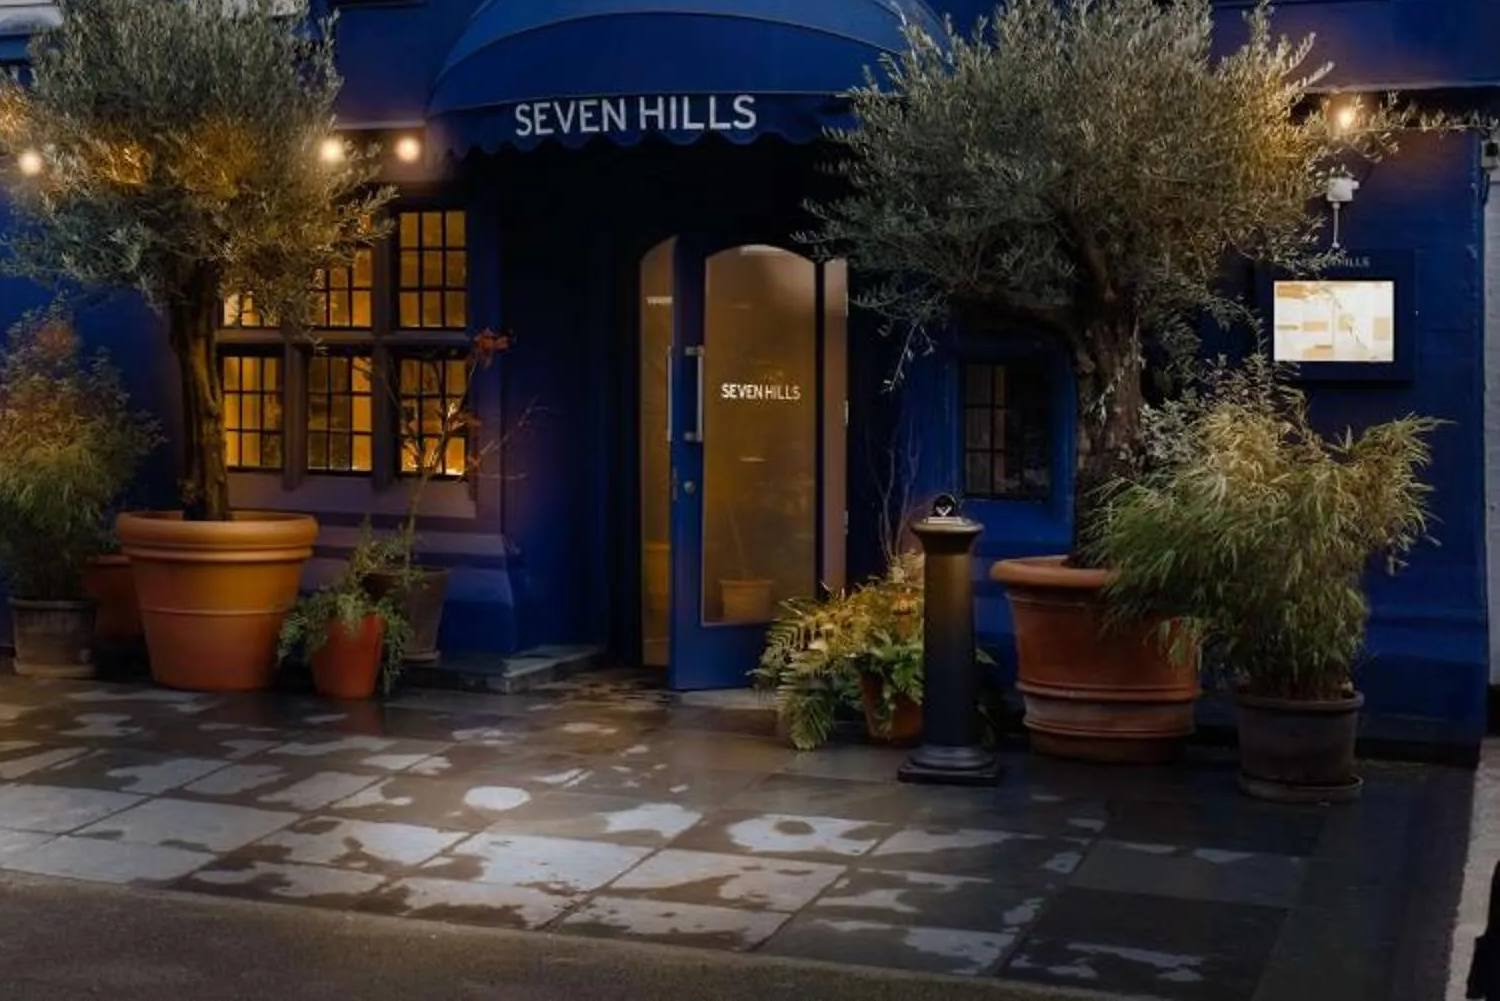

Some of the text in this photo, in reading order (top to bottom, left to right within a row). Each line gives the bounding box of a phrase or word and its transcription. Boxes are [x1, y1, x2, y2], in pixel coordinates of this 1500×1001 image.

[514, 94, 756, 136] SEVEN HILLS
[721, 383, 801, 399] SEVEN HILLS
